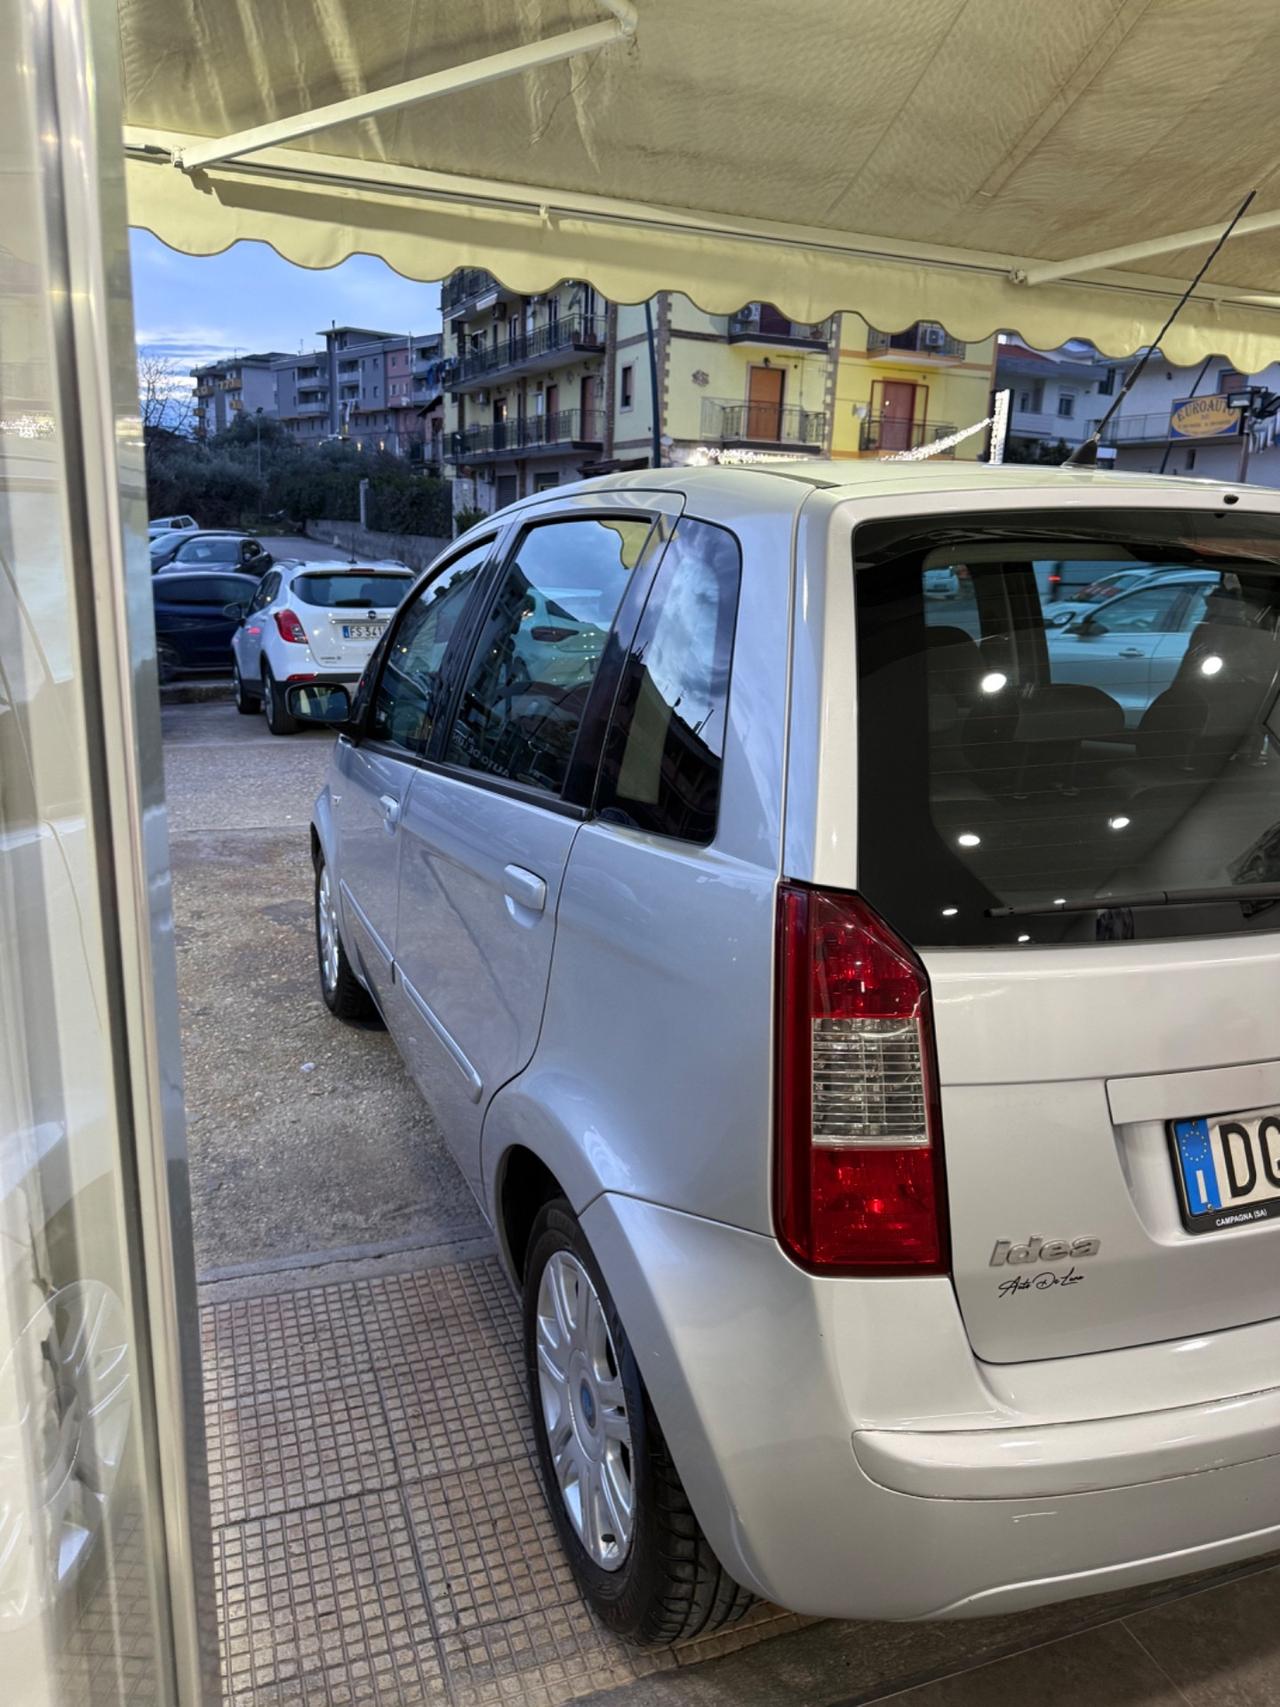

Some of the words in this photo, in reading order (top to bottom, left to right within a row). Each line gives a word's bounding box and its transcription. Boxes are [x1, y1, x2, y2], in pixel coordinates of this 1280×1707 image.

[1218, 1116, 1280, 1198] DG
[1196, 1169, 1208, 1203] I
[1215, 1211, 1253, 1226] CAMPAGNA
[1254, 1208, 1267, 1219] (SA)
[989, 1234, 1100, 1267] Idea
[998, 1275, 1031, 1298] Auto
